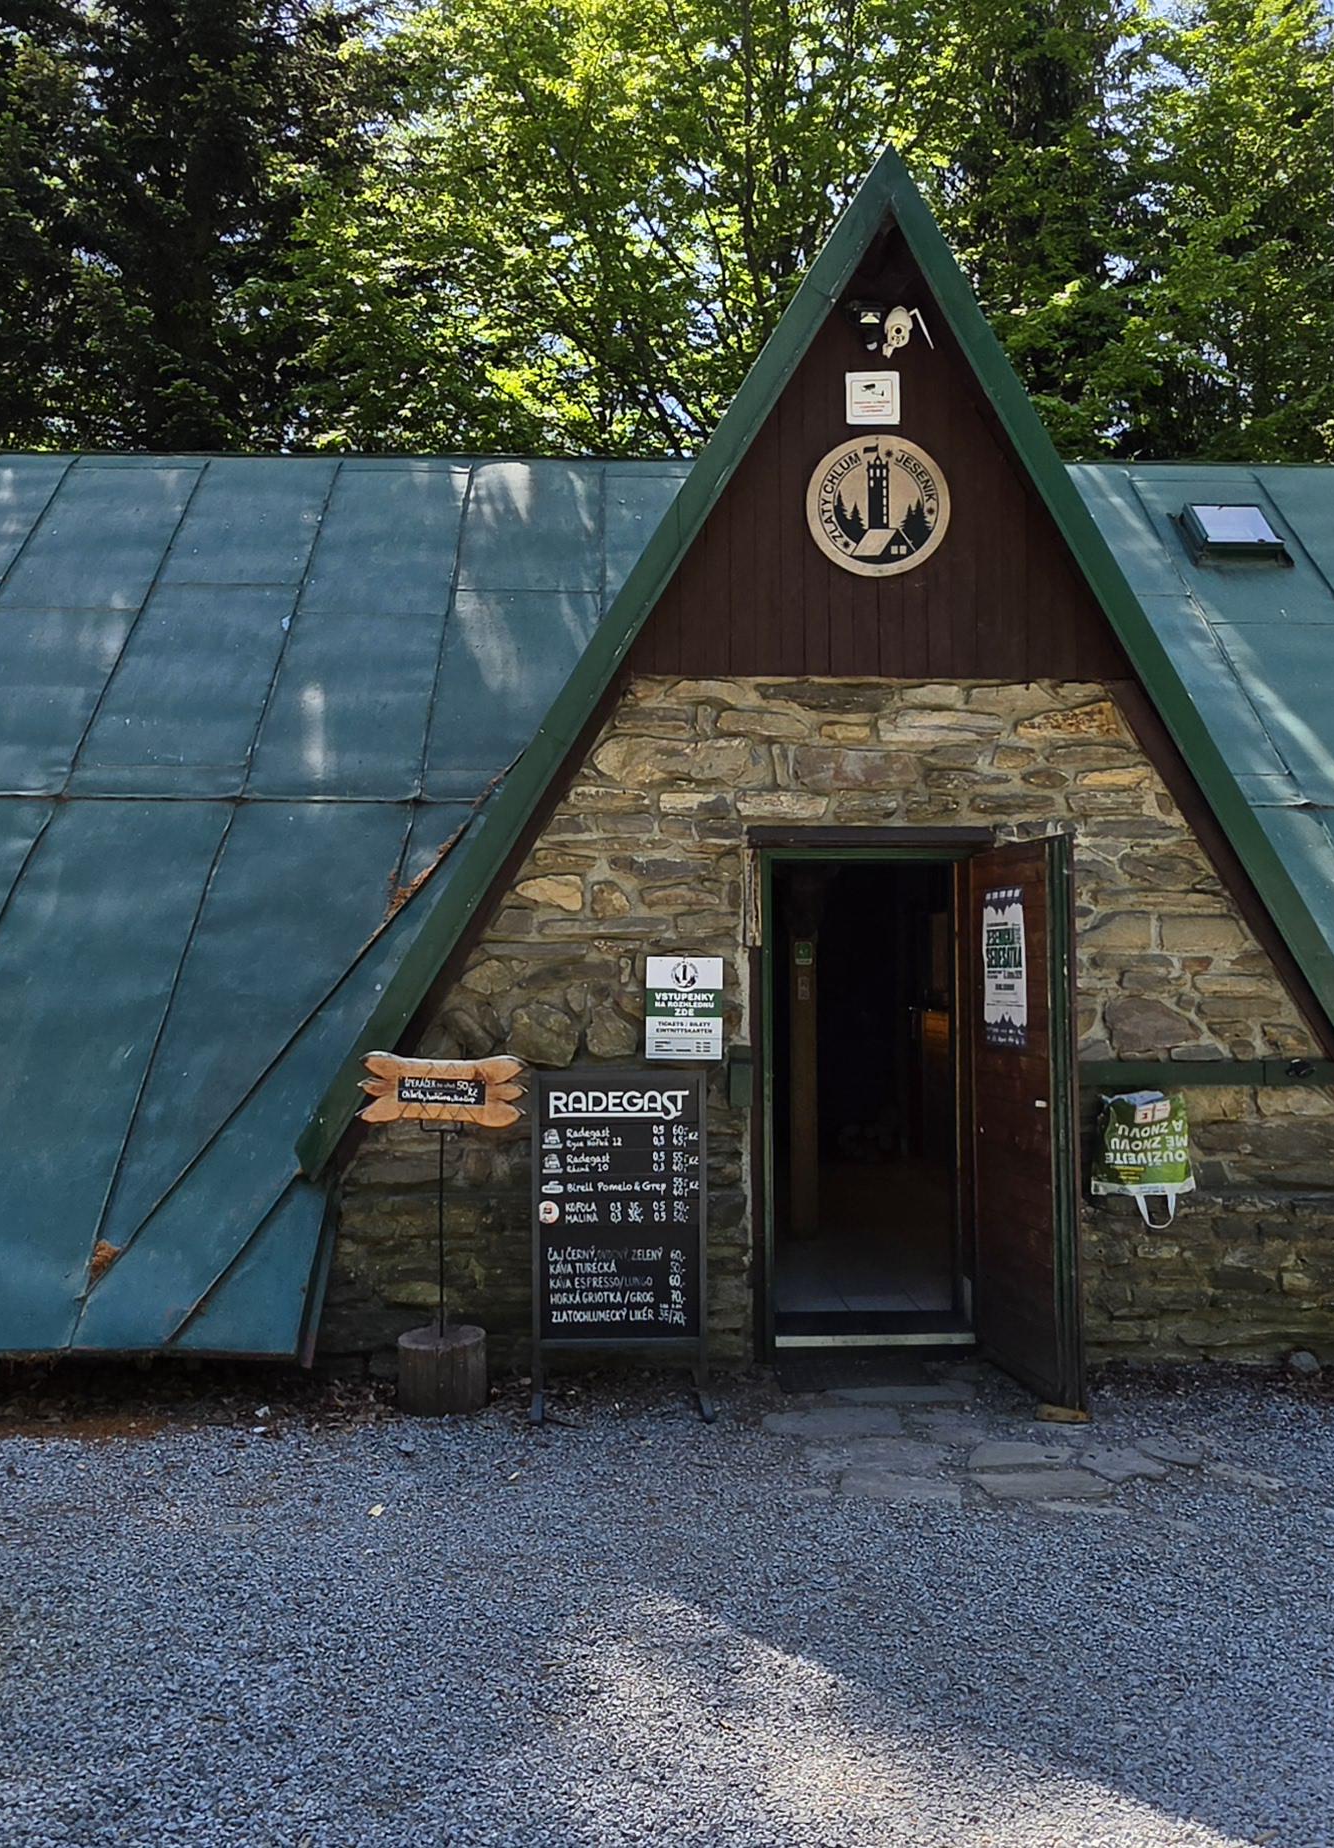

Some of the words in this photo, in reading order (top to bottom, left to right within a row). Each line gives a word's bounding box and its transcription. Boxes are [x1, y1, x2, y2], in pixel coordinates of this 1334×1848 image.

[823, 452, 862, 494] CHLUM
[895, 454, 937, 503] JESENIK
[821, 498, 844, 542] ZLATY
[654, 992, 715, 1001] VSTUPENKY
[674, 1008, 695, 1016] ZDE
[548, 1089, 690, 1120] RADEGAST
[566, 1126, 611, 1140] Radegast
[1115, 1121, 1169, 1138] ZNOVU.
[1171, 1120, 1184, 1132] A
[612, 1137, 622, 1146] 12
[1110, 1137, 1162, 1151] ZNOVU
[1166, 1133, 1188, 1150] MĚ
[566, 1152, 611, 1167] Radegast
[1104, 1149, 1187, 1167] OUŽÍVEJTE
[597, 1163, 609, 1172] 10
[566, 1181, 594, 1193] Birell
[597, 1181, 633, 1192] Pomelo
[633, 1180, 641, 1191] &
[641, 1180, 667, 1196] Grep
[565, 1201, 598, 1212] KOFOLA
[565, 1212, 599, 1223] MALINA
[547, 1246, 564, 1261] ČAJ
[631, 1246, 663, 1261] ZELENÝ
[549, 1260, 573, 1275] KÁVA
[549, 1276, 572, 1290] KÁVA
[550, 1290, 581, 1304] HORKÁ
[582, 1291, 622, 1304] GRIOTKA
[551, 1307, 627, 1322] ZLATOCHLUMECKÝ
[629, 1306, 655, 1321] LIKÉR
